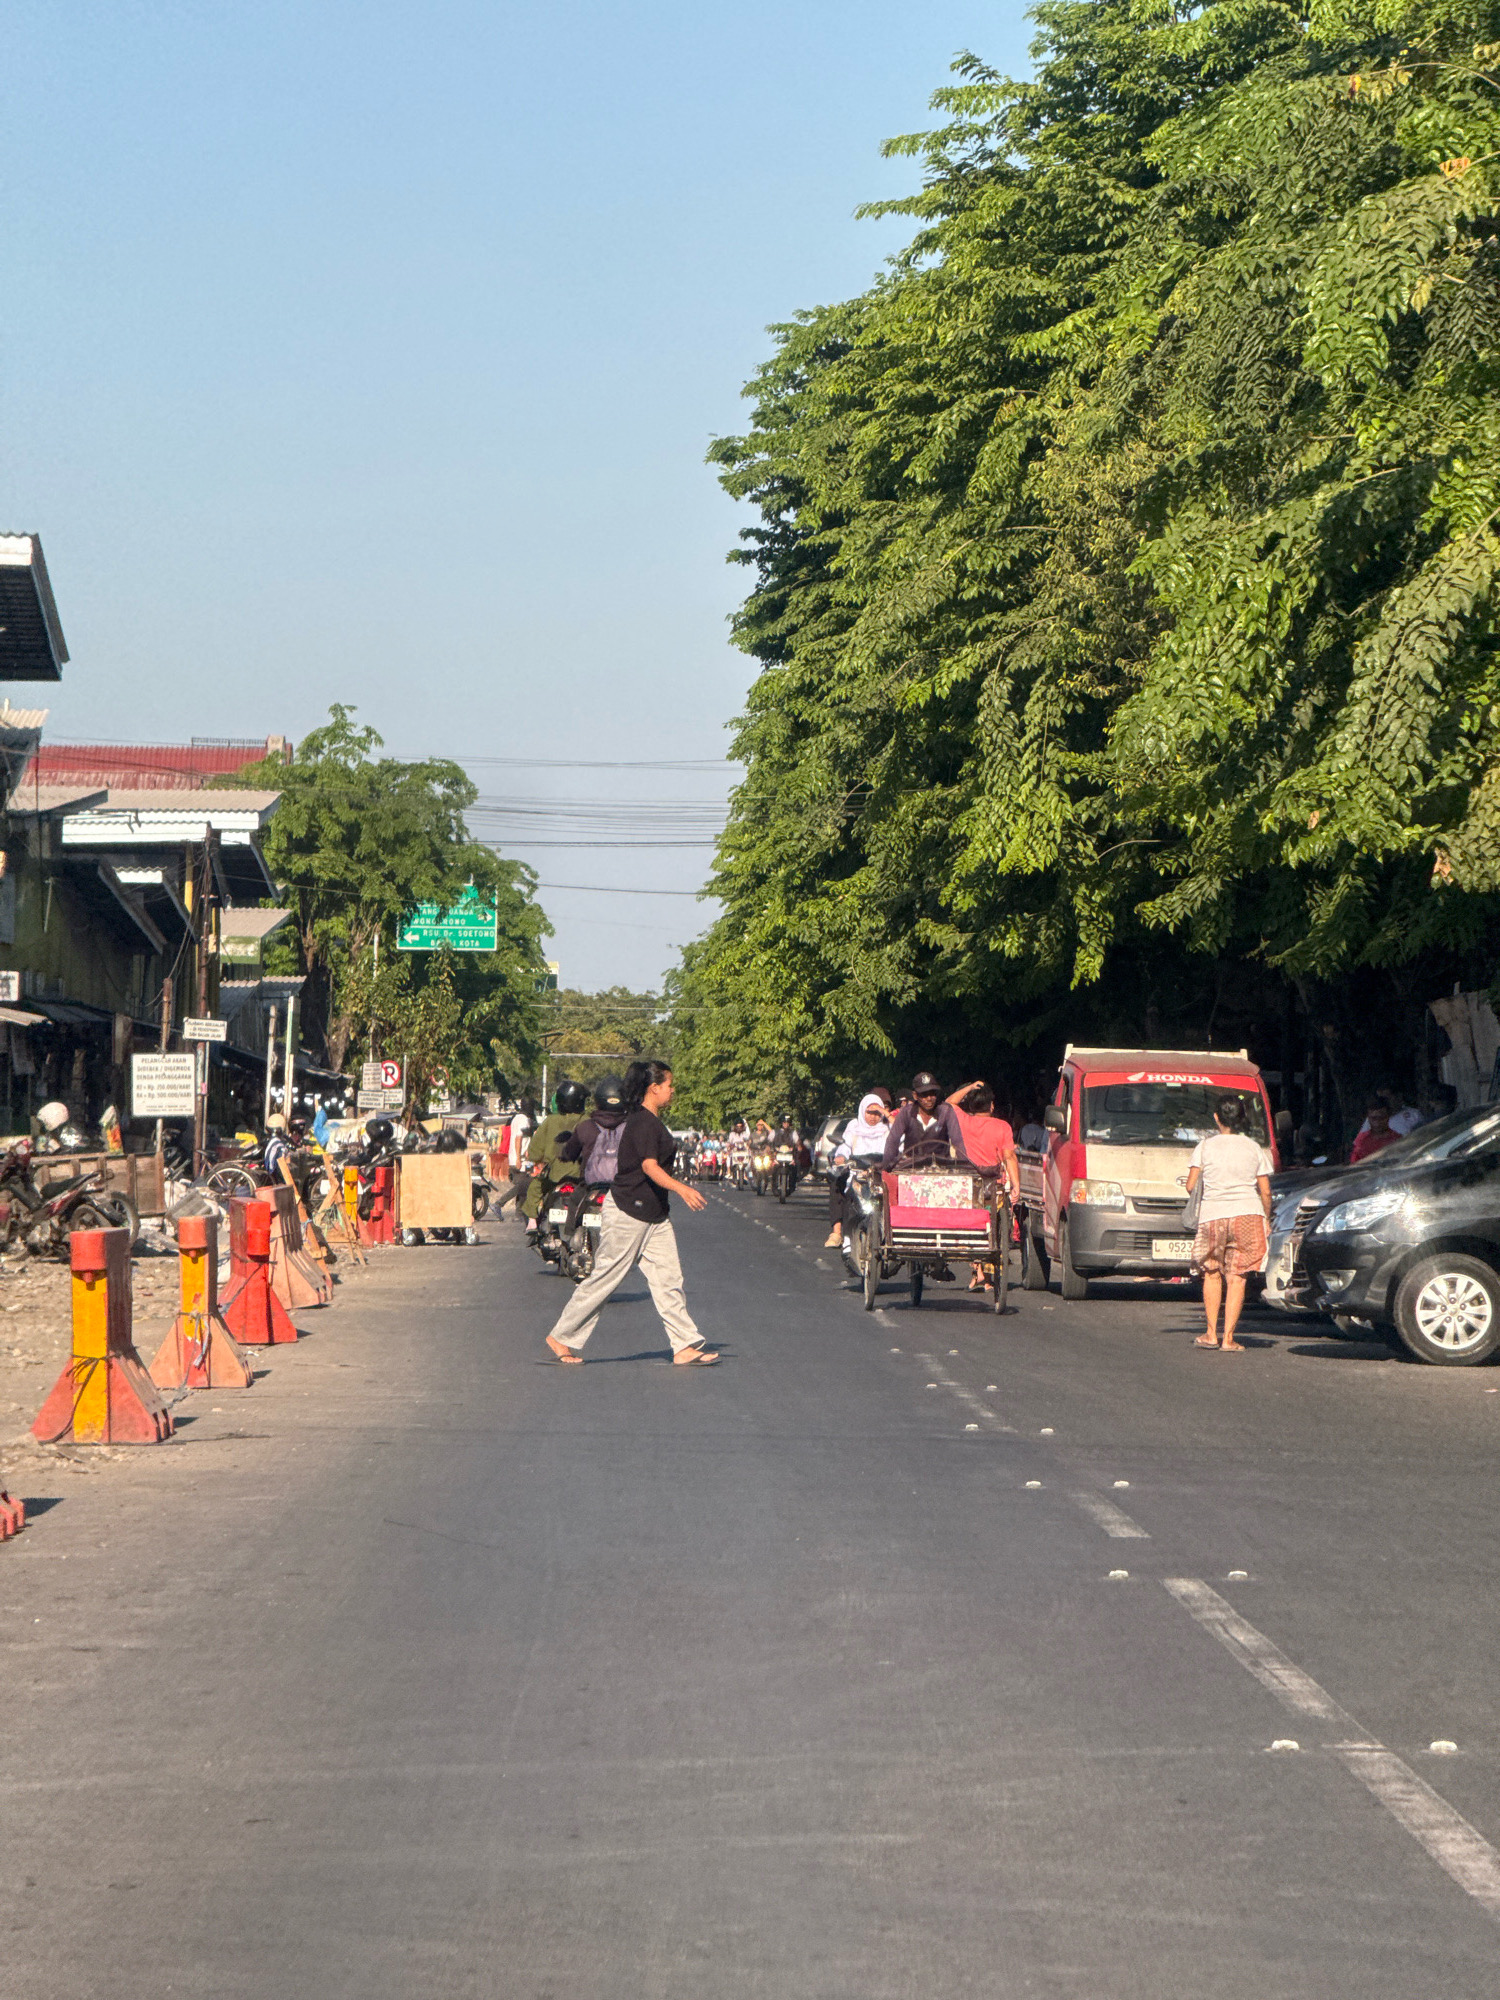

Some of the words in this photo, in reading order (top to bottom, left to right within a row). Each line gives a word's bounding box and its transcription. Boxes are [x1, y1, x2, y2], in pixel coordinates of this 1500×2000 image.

[413, 917, 466, 925] WONOROMO
[458, 930, 495, 938] SOETOMO
[430, 939, 456, 947] BAI
[459, 940, 480, 948] KOTA
[1147, 1074, 1213, 1084] HONDA
[1155, 1242, 1160, 1252] L
[1169, 1242, 1193, 1253] 9523
